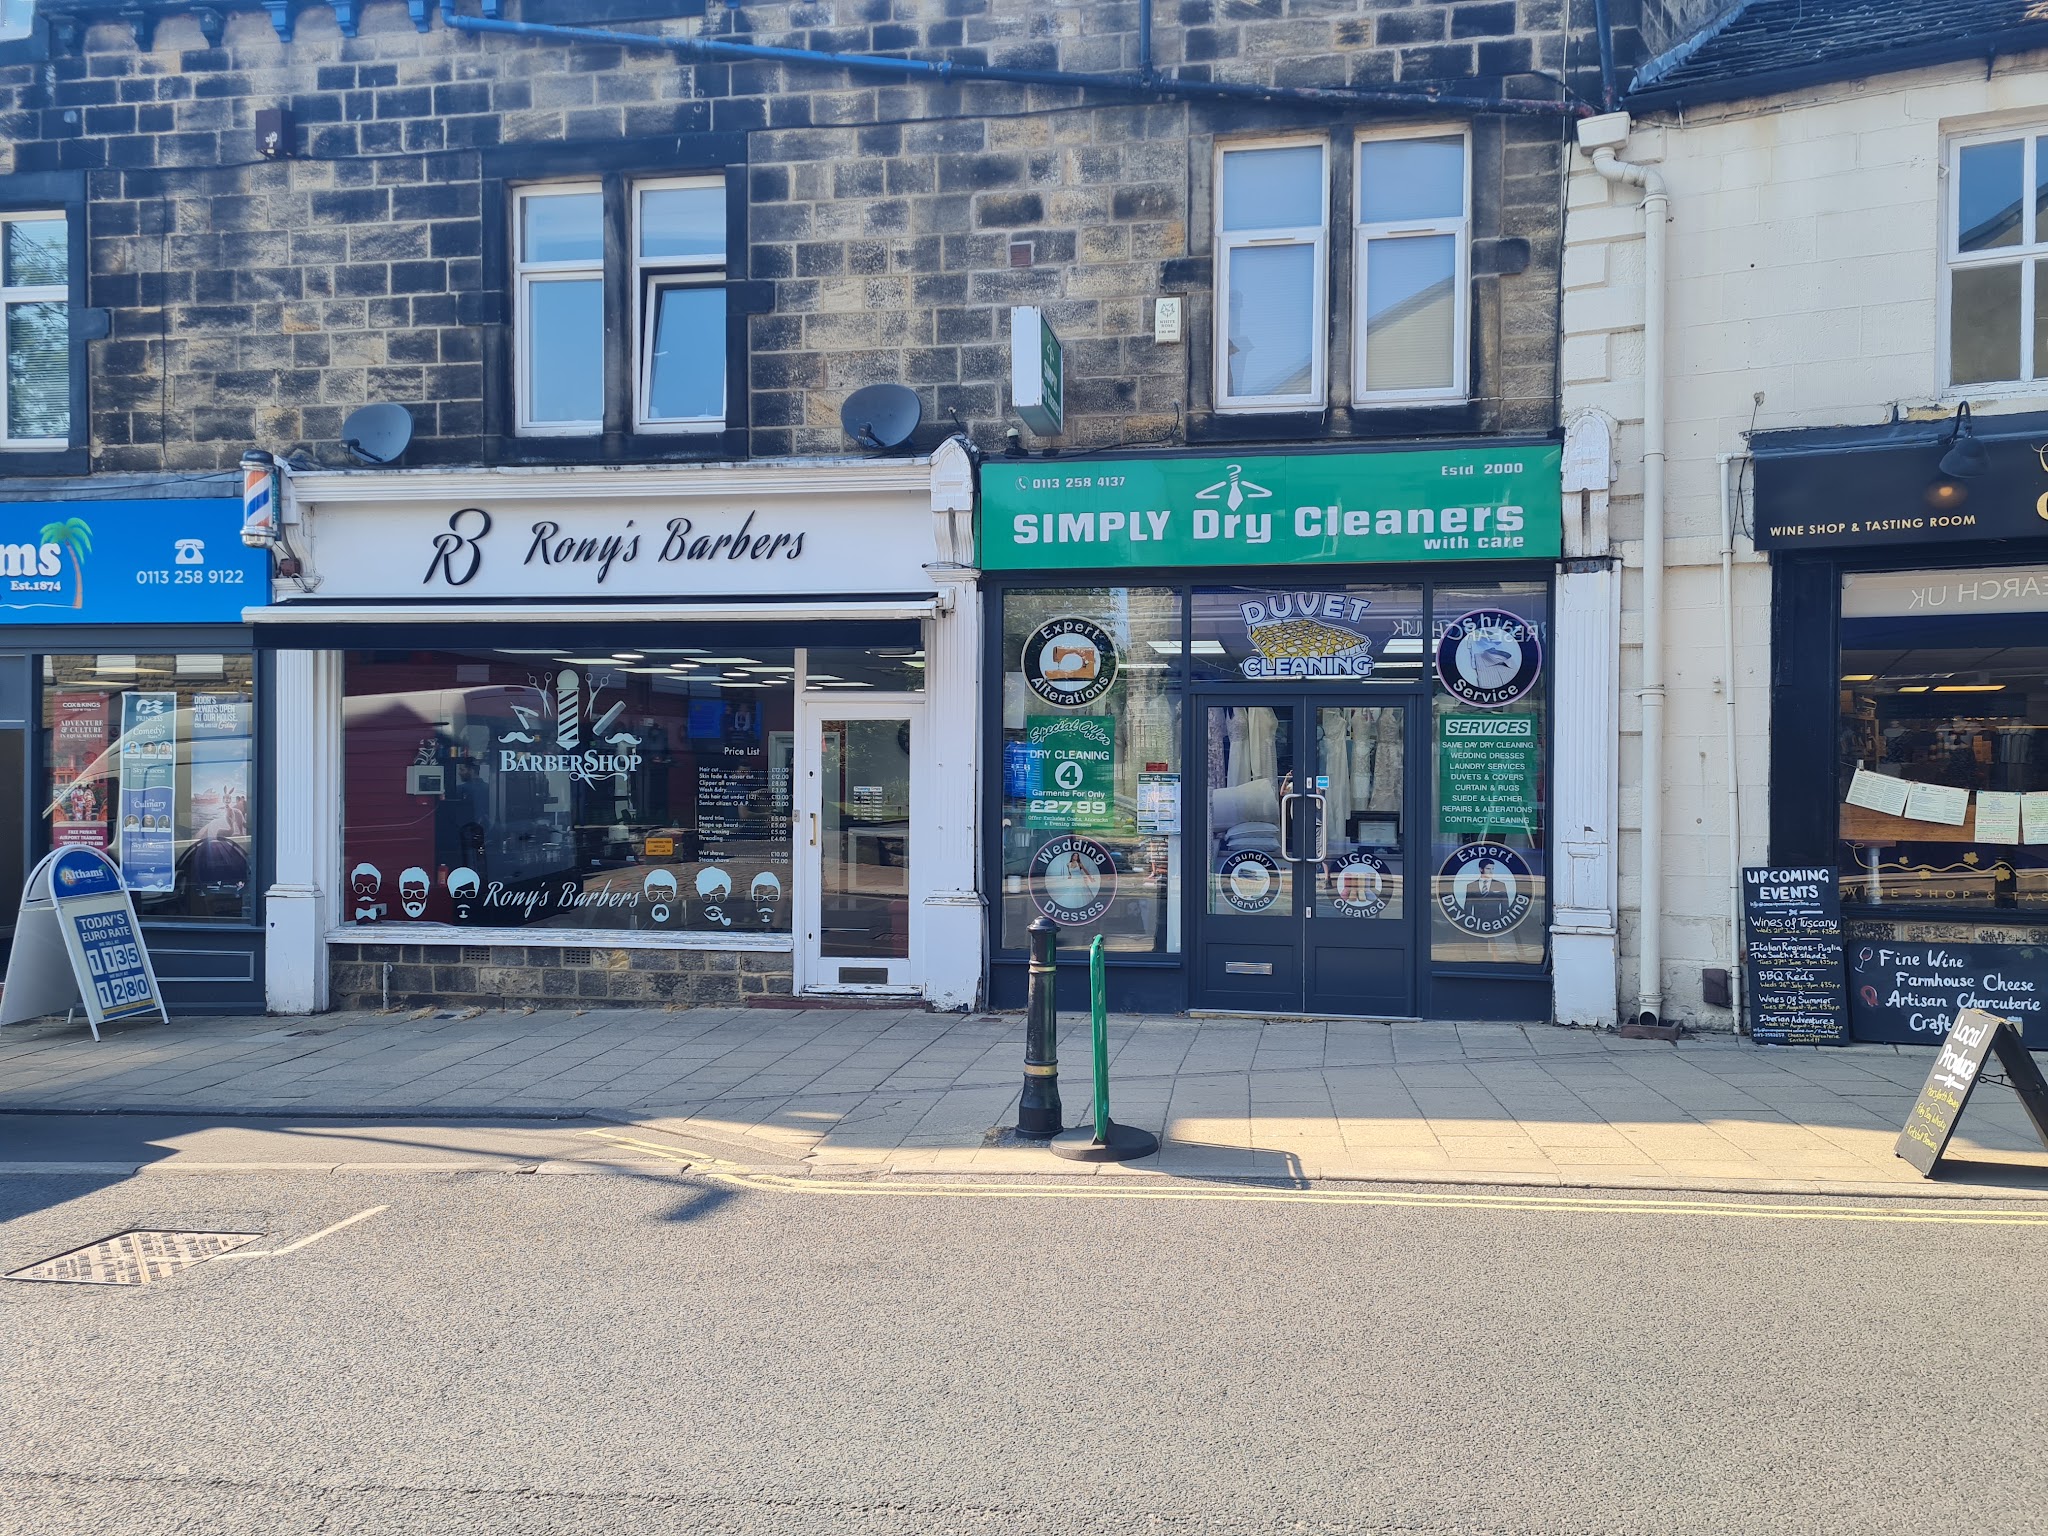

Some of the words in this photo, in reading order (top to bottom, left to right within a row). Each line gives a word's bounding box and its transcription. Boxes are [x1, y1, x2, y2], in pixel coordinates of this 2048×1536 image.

[1484, 462, 1523, 475] 2000
[1032, 478, 1060, 489] 0113
[1065, 477, 1092, 489] 258
[1097, 476, 1126, 488] 4137
[1013, 510, 1171, 544] SIMPLY
[1193, 509, 1272, 544] Dry
[1294, 504, 1524, 538] Cleaners
[1770, 525, 1804, 537] WINE
[1809, 523, 1846, 536] SHOP
[1851, 522, 1860, 533] &
[1865, 518, 1924, 531] TASTING
[1929, 515, 1976, 527] ROOM
[523, 519, 640, 585] Rony's
[657, 509, 806, 563] Barbers
[1424, 537, 1472, 550] with
[1477, 535, 1524, 548] care
[136, 570, 169, 584] 0113
[174, 570, 203, 584] 258
[208, 570, 244, 584] 9122
[10, 580, 61, 592] Est.1874
[1239, 592, 1372, 625] DUVET
[1040, 621, 1100, 640] Expert
[1242, 656, 1375, 676] CLEANING
[1031, 675, 1108, 704] Alterations
[1453, 679, 1519, 702] Service
[220, 704, 236, 712] OPEN
[203, 713, 216, 721] OUR
[133, 727, 162, 736] Comedy
[1030, 719, 1079, 744] Special
[1079, 721, 1110, 746] Offer
[1447, 722, 1529, 734] SERVICES
[724, 746, 744, 756] Price
[746, 746, 760, 756] List
[1030, 750, 1051, 759] DRY
[1055, 750, 1110, 760] CLEANING
[1060, 766, 1078, 786] 4
[1032, 789, 1070, 797] Garments
[1088, 791, 1106, 800] Only
[134, 800, 166, 810] Culinary
[1030, 800, 1106, 814] £27.99
[1038, 838, 1107, 866] Wedding
[1228, 852, 1273, 868] Laundry
[1456, 846, 1514, 864] Expert
[1336, 853, 1383, 870] UGGS
[64, 869, 104, 880] Althams
[1747, 869, 1829, 884] UPCOMING
[483, 880, 549, 918] Rony's
[557, 879, 639, 908] Barbers
[1760, 885, 1818, 900] EVENTS
[1915, 888, 1970, 899] SHOP
[1987, 891, 1995, 900] &
[1231, 895, 1271, 910] Service
[1333, 898, 1386, 918] Cleaned
[1043, 900, 1105, 922] Dresses
[80, 914, 125, 930] TODAY'S
[1750, 916, 1783, 928] Wines
[1784, 918, 1797, 930] of
[1797, 917, 1838, 930] Tuscany
[82, 930, 106, 943] EURO
[108, 926, 130, 938] RATE
[1879, 950, 1920, 968] Fine
[1928, 950, 1964, 968] Wine
[1758, 971, 1784, 981] BBQ
[1785, 970, 1814, 980] Reds
[1895, 972, 1975, 989] Farmhouse
[1983, 974, 2036, 992] Cheese
[1758, 994, 1784, 1004] Wines
[1798, 996, 1836, 1004] Summer
[1885, 990, 1948, 1008] Artisan
[1956, 993, 2042, 1011] Charcuterie
[1759, 1014, 1790, 1022] Iberian
[1791, 1016, 1834, 1024] Adventures
[1909, 1013, 1951, 1035] Craft
[1953, 1016, 1988, 1048] Local
[1937, 1044, 1977, 1081] Produce
